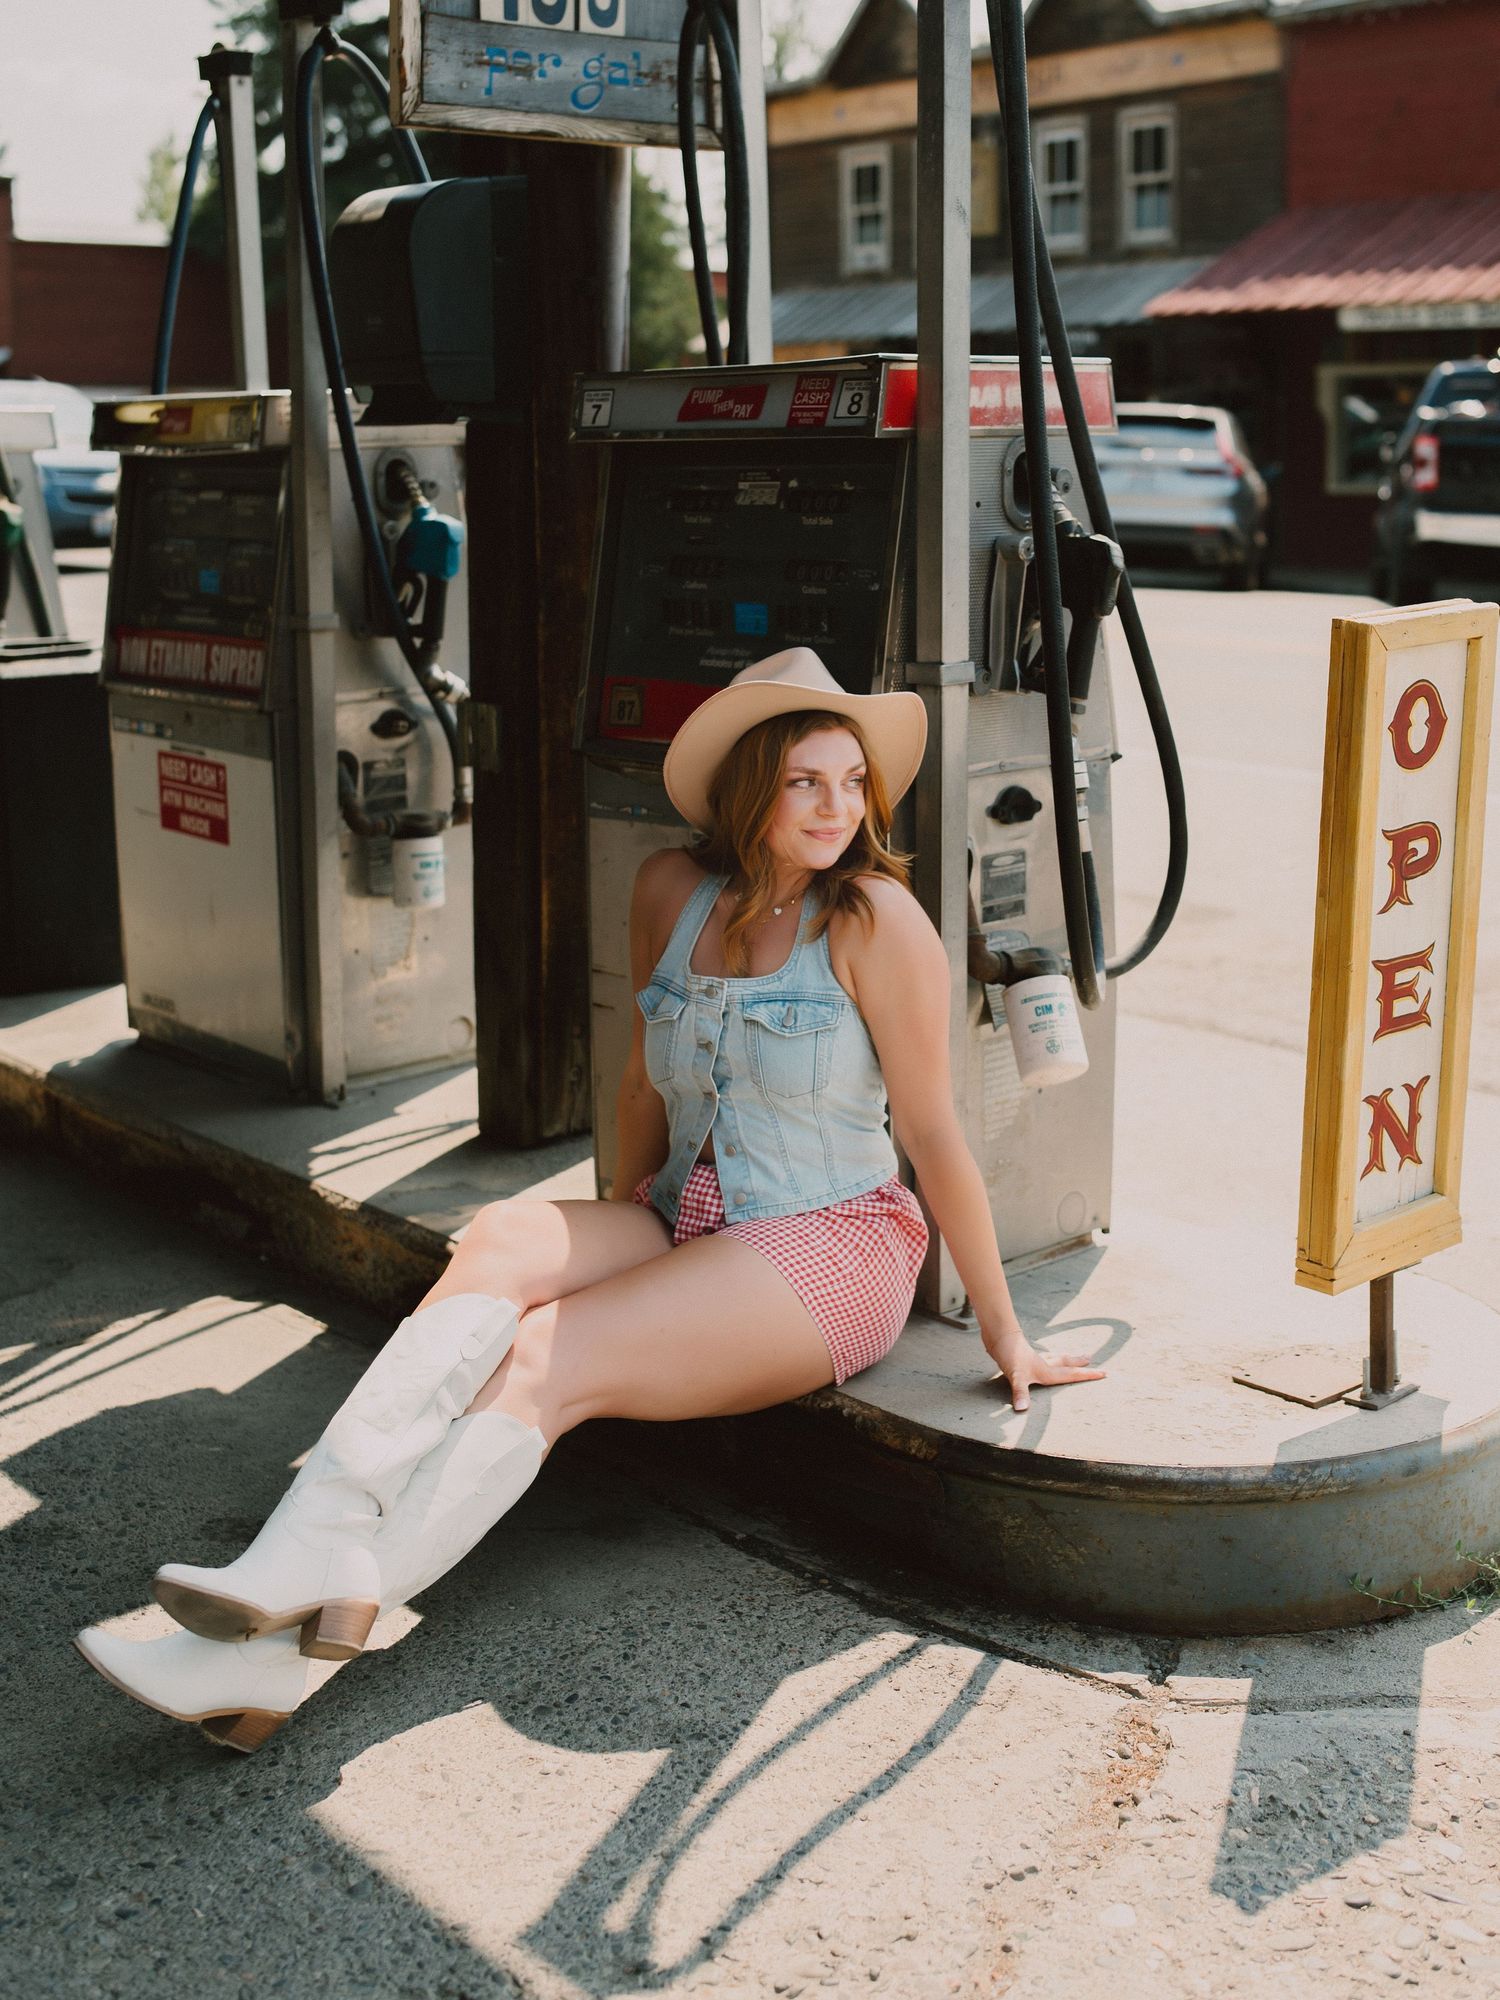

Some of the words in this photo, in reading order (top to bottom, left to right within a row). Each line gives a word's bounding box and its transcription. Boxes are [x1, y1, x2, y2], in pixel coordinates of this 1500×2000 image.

[484, 47, 562, 96] per
[800, 377, 831, 390] NEED
[690, 387, 723, 405] PUMP
[713, 399, 734, 416] THEN
[732, 402, 755, 420] PAY
[794, 391, 831, 405] CASH?
[846, 391, 864, 416] 8
[591, 403, 603, 425] 7
[149, 637, 208, 682] ETHANOL
[617, 699, 636, 721] 87
[189, 762, 218, 789] CASH
[1360, 678, 1447, 1182] OPEN
[1034, 1003, 1054, 1017] CIM
